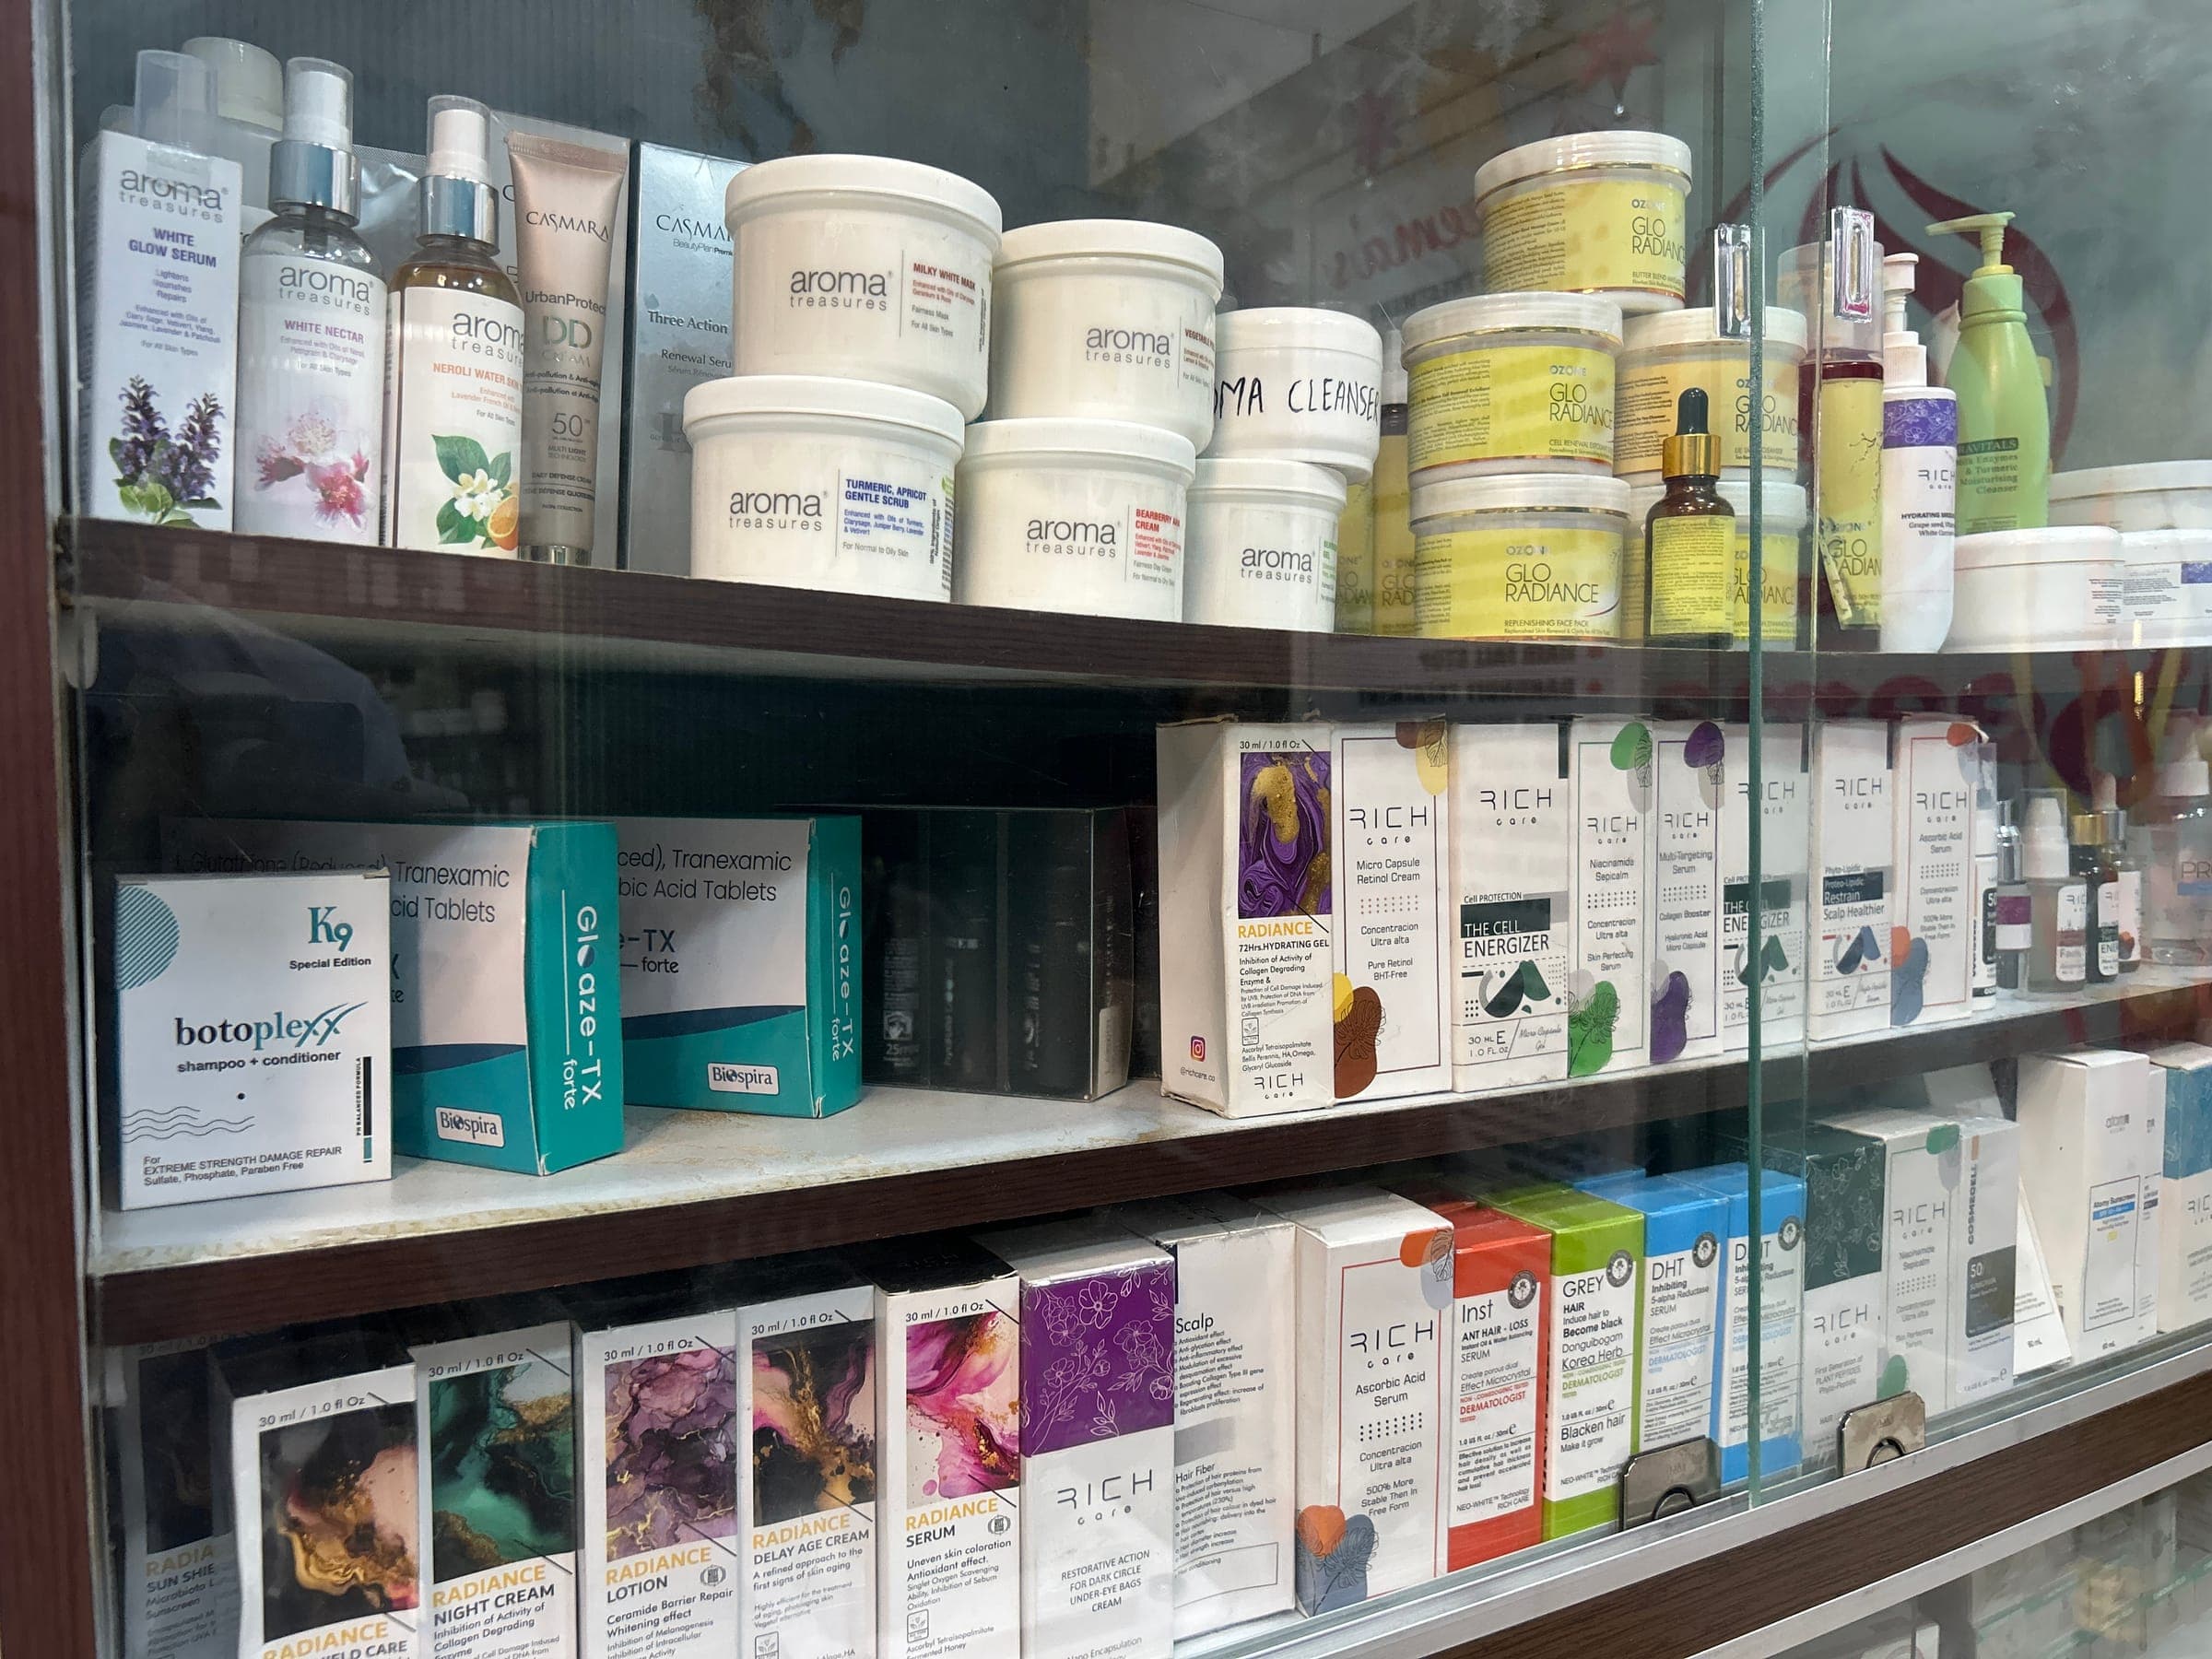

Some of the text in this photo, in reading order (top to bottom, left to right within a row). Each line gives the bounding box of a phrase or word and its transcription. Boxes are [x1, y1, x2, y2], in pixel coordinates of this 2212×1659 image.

[121, 170, 222, 210] aroma
[120, 192, 223, 224] treasures
[153, 228, 194, 246] WHITE
[526, 210, 609, 242] CASMARA
[1631, 217, 1665, 238] GLO
[129, 240, 217, 267] GLOW SERUM
[1632, 236, 1686, 265] RADIANC
[280, 266, 371, 303] aroma
[790, 268, 888, 297] aroma
[279, 288, 371, 316] treasures
[790, 295, 888, 312] treasures
[285, 320, 364, 344] WHITE NECTAR
[648, 311, 728, 335] Three Action
[1087, 326, 1171, 356] aroma
[1087, 349, 1171, 369] treasures
[433, 362, 505, 384] NEROLI WATER
[1214, 376, 1264, 419] MA
[1549, 382, 1587, 403] GLO
[845, 490, 909, 509] GENTLE SCRUB
[846, 479, 927, 502] TURMERIC, APRICOT
[1976, 485, 2018, 495] Cleanser
[730, 491, 822, 517] aroma
[730, 516, 822, 532] treasures
[1027, 519, 1116, 546] aroma
[1027, 541, 1116, 558] treasures
[1241, 547, 1312, 572] aroma
[1828, 539, 1867, 559] GLO
[1241, 567, 1312, 584] treasures
[1506, 563, 1550, 583] GLO
[1506, 582, 1598, 605] RADIANCE
[1480, 788, 1552, 810] RICH
[1835, 777, 1882, 798] RICH
[1916, 792, 1967, 810] RICH
[1349, 805, 1427, 830] RICH
[1587, 817, 1637, 832] RICH
[1665, 812, 1709, 829] RICH
[673, 849, 793, 872] Tranexamic
[1357, 858, 1420, 871] Micro Capsule
[396, 861, 510, 888] Tranexamic
[1357, 871, 1421, 885] Retinol Cream
[653, 878, 699, 899] Acid
[705, 880, 777, 902] Tablets
[1465, 891, 1522, 904] Cell PROTECTION
[1824, 890, 1861, 904] Restrain
[308, 906, 354, 953] K9
[1238, 921, 1313, 939] RADIANCE
[1360, 923, 1418, 935] Concentracion
[1465, 920, 1521, 937] THE CELL
[1465, 934, 1549, 959] ENERGIZER
[289, 956, 372, 971] Special Edition
[641, 957, 679, 974] forte
[1240, 963, 1305, 977] Collagen Degrading
[1368, 958, 1413, 970] Pure Retinol
[175, 1001, 369, 1051] botoplexx
[177, 1057, 246, 1073] shampoo
[264, 1050, 341, 1066] conditioner
[562, 1058, 577, 1112] forte
[712, 1066, 772, 1088] Biospira
[1253, 1073, 1304, 1089] RICH
[440, 1112, 499, 1135] Biospira
[144, 1155, 160, 1165] For
[144, 1146, 343, 1176] EXTREME STRENGTH DAMAGE REPAIR
[144, 1160, 305, 1187] Sulfate, Phosphate, Paraben Free
[1893, 1201, 1946, 1226] RICH
[2188, 1194, 2212, 1214] RIC
[1652, 1257, 1685, 1281] DHT
[1971, 1264, 1983, 1278] 50
[1563, 1275, 1604, 1299] GREY
[1651, 1279, 1688, 1294] Inhibiting
[1462, 1299, 1493, 1324] Inst
[1563, 1302, 1584, 1315] HAIR
[1650, 1304, 1677, 1318] SERUM
[1814, 1303, 1867, 1334] RICH
[1175, 1312, 1214, 1335] Scalp
[1563, 1318, 1622, 1338] Become black
[1350, 1320, 1433, 1353] RICH
[1562, 1332, 1622, 1353] Donguibogam
[1461, 1349, 1490, 1362] SERUM
[1355, 1371, 1426, 1395] Ascorbic Acid
[1562, 1369, 1624, 1391] DERMATOLOGIST
[1373, 1392, 1408, 1407] Serum
[1460, 1392, 1526, 1416] DERMATOLOGIST
[1560, 1414, 1625, 1441] Blacken hair
[1359, 1441, 1422, 1463] Concentracion
[1370, 1454, 1412, 1473] Ultra alta
[1175, 1464, 1215, 1484] Hair Fiber
[1057, 1468, 1152, 1509] RICH
[905, 1498, 998, 1532] RADIANCE
[753, 1513, 850, 1550] RADIANCE
[905, 1525, 956, 1548] SERUM
[754, 1528, 870, 1566] DELAY AGE CREAM
[907, 1539, 1012, 1570] Uneven skin coloration
[146, 1545, 214, 1577] RADIA
[606, 1547, 712, 1587] RADIANCE
[907, 1554, 989, 1582] Antioxidant effect.
[1061, 1548, 1150, 1581] RESTORATIVE ACTION
[433, 1565, 547, 1607] RADIANCE
[607, 1575, 668, 1605] LOTION
[1069, 1565, 1142, 1593] FOR DARK CIRCLE
[1069, 1578, 1142, 1606] UNDER-EYE BAGS
[433, 1583, 555, 1626] NIGHT CREAM
[607, 1588, 734, 1627] Ceramide Barrier Repair
[1091, 1596, 1122, 1613] CREAM
[434, 1619, 535, 1653] Collagen Degrading
[607, 1609, 692, 1640] Whitening effect
[365, 1641, 407, 1658] CARE
